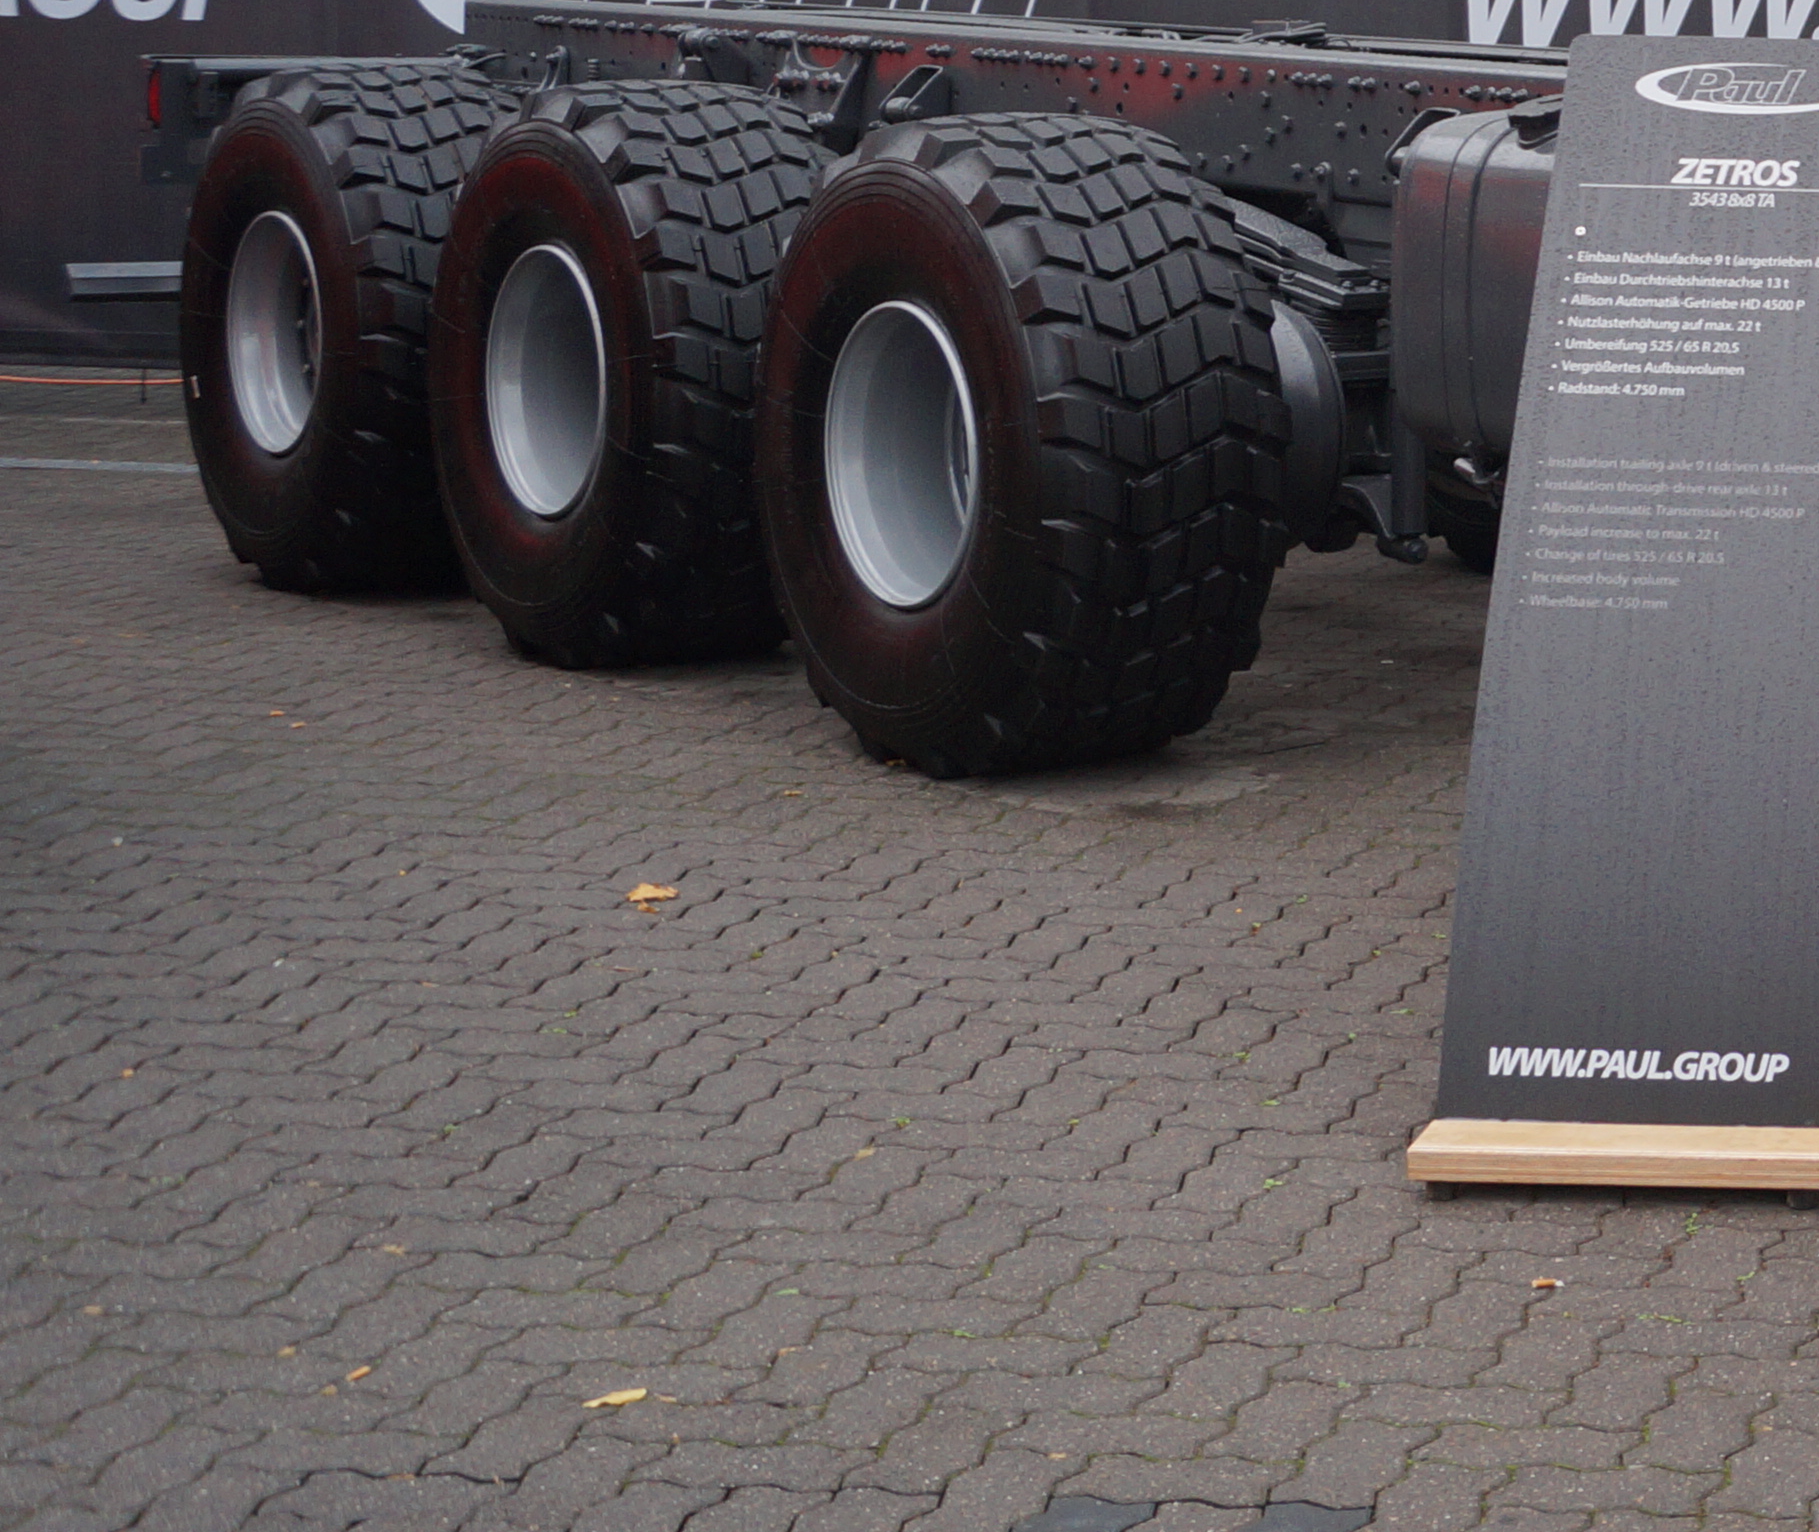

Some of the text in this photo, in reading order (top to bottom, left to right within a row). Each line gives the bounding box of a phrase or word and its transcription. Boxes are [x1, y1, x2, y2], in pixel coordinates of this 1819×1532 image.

[1670, 157, 1801, 188] ZETROS
[1689, 192, 1728, 208] 3543
[1757, 194, 1776, 209] TA
[1576, 250, 1621, 263] Einbau
[1621, 251, 1713, 266] Nachlaufachse
[1713, 253, 1724, 266] 9
[1723, 255, 1732, 266] t
[1732, 254, 1814, 270] (angetrieben
[1573, 271, 1790, 289] Einbau Durchtriebshinterachse 13 t
[1570, 293, 1806, 311] Allison Automatik-Getriebe HD 4500 P
[1567, 315, 1762, 333] Nutzlasterhöhung auf max. 22 t
[1564, 337, 1648, 354] Umbereifung
[1649, 339, 1674, 352] 525
[1674, 340, 1683, 352] /
[1682, 340, 1700, 353] 65
[1701, 340, 1712, 352] R
[1561, 359, 1745, 376] Vergrößertes Aufbauvolumen
[1557, 381, 1685, 397] Radstand: 4.750 mm
[1487, 1046, 1790, 1083] WWW.PAUL.GROUP
